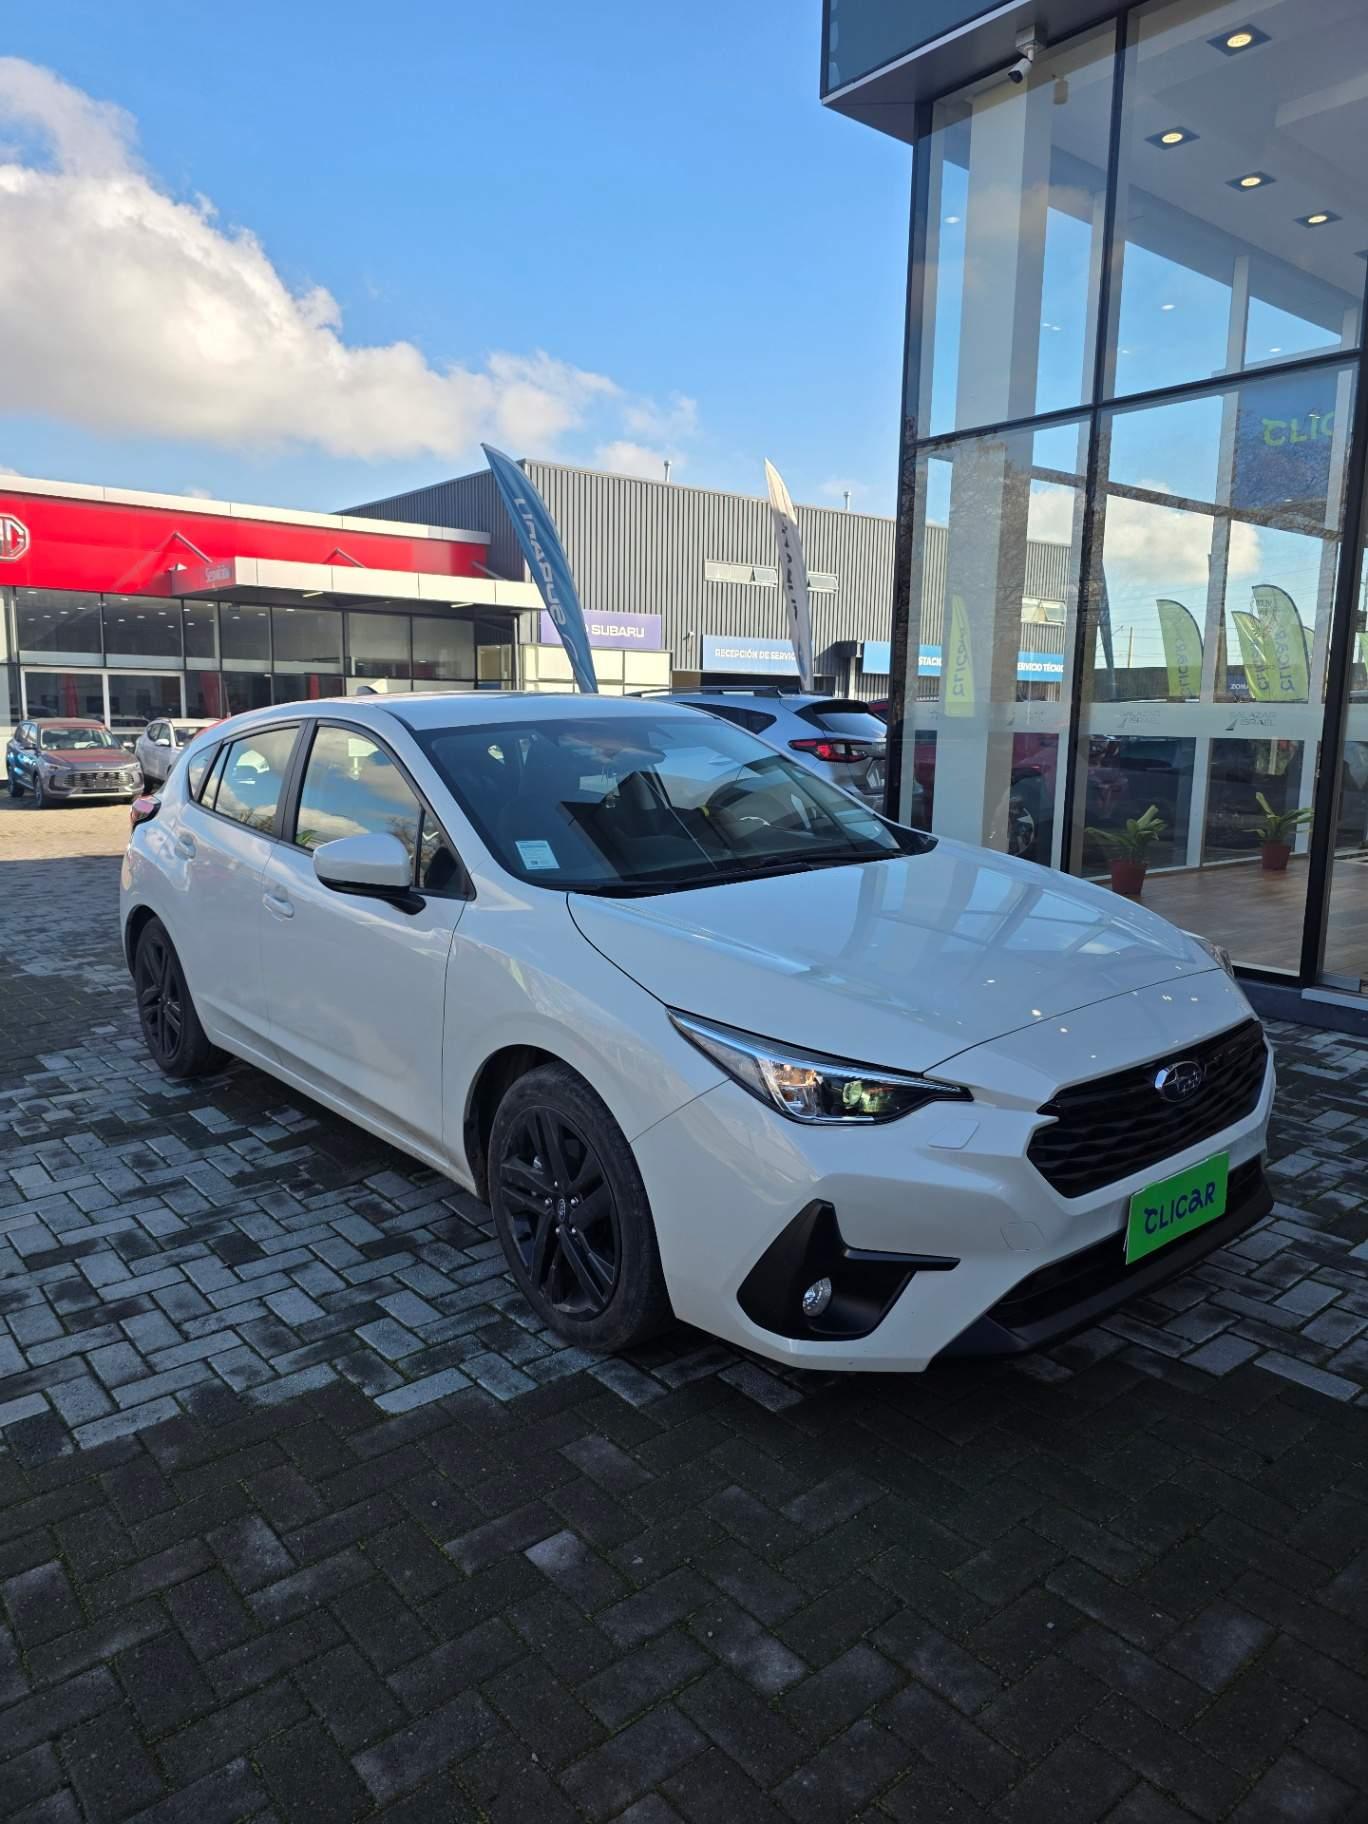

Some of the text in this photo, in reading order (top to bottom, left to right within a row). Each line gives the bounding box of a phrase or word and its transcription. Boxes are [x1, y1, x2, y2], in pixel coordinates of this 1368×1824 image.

[1263, 411, 1335, 446] CLIC
[591, 624, 645, 638] SUBARU
[714, 648, 797, 661] RECEPCIÓN DE SERVIC
[1017, 662, 1042, 672] ERVICIO
